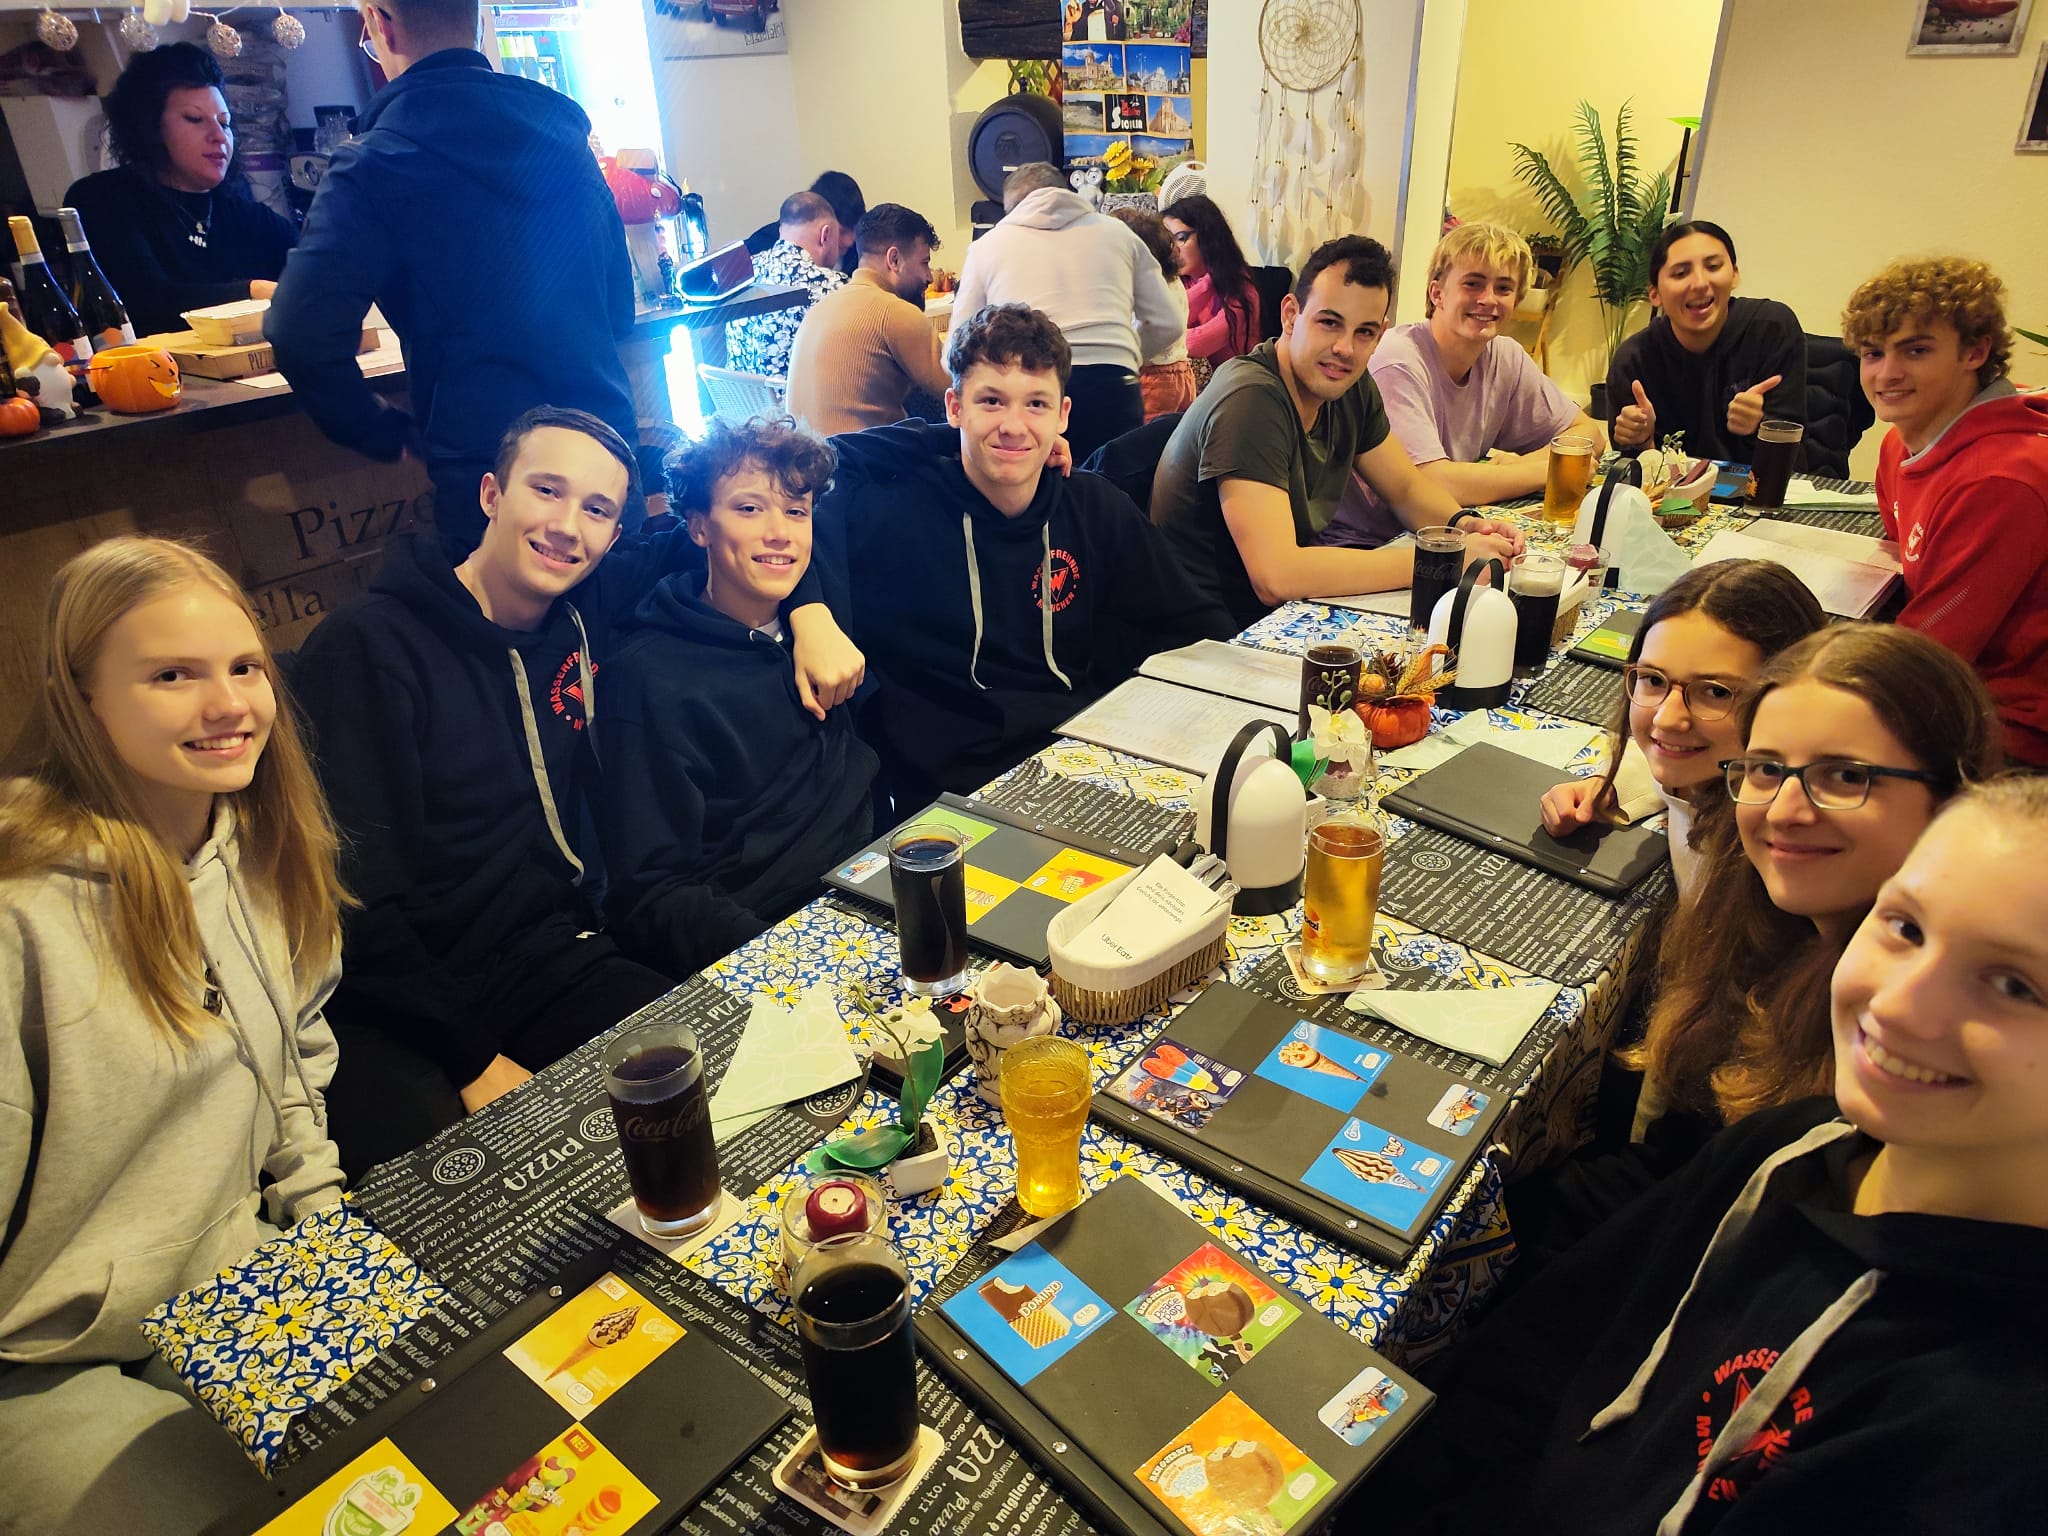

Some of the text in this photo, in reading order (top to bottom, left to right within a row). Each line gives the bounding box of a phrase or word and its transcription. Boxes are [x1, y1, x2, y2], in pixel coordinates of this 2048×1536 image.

[248, 345, 276, 370] PIZZ
[1101, 933, 1117, 949] Uber
[502, 1134, 583, 1194] PIZZA
[467, 1195, 508, 1224] Pizza
[482, 1219, 515, 1244] pizza
[522, 1185, 567, 1216] migliore
[567, 1159, 606, 1186] quando
[410, 1212, 453, 1242] simbolo
[425, 1227, 455, 1249] una
[458, 1176, 600, 1272] amoroso che vorrei.
[604, 1281, 623, 1300] NEU
[668, 1266, 695, 1290] La
[689, 1280, 727, 1309] Pizza
[729, 1308, 752, 1327] un
[1018, 1281, 1063, 1319] DOMINO
[652, 1282, 717, 1329] linguaggio
[713, 1319, 777, 1364] universale
[1154, 1298, 1181, 1320] peace
[921, 1484, 947, 1511] rito.
[998, 1476, 1033, 1522] migliore
